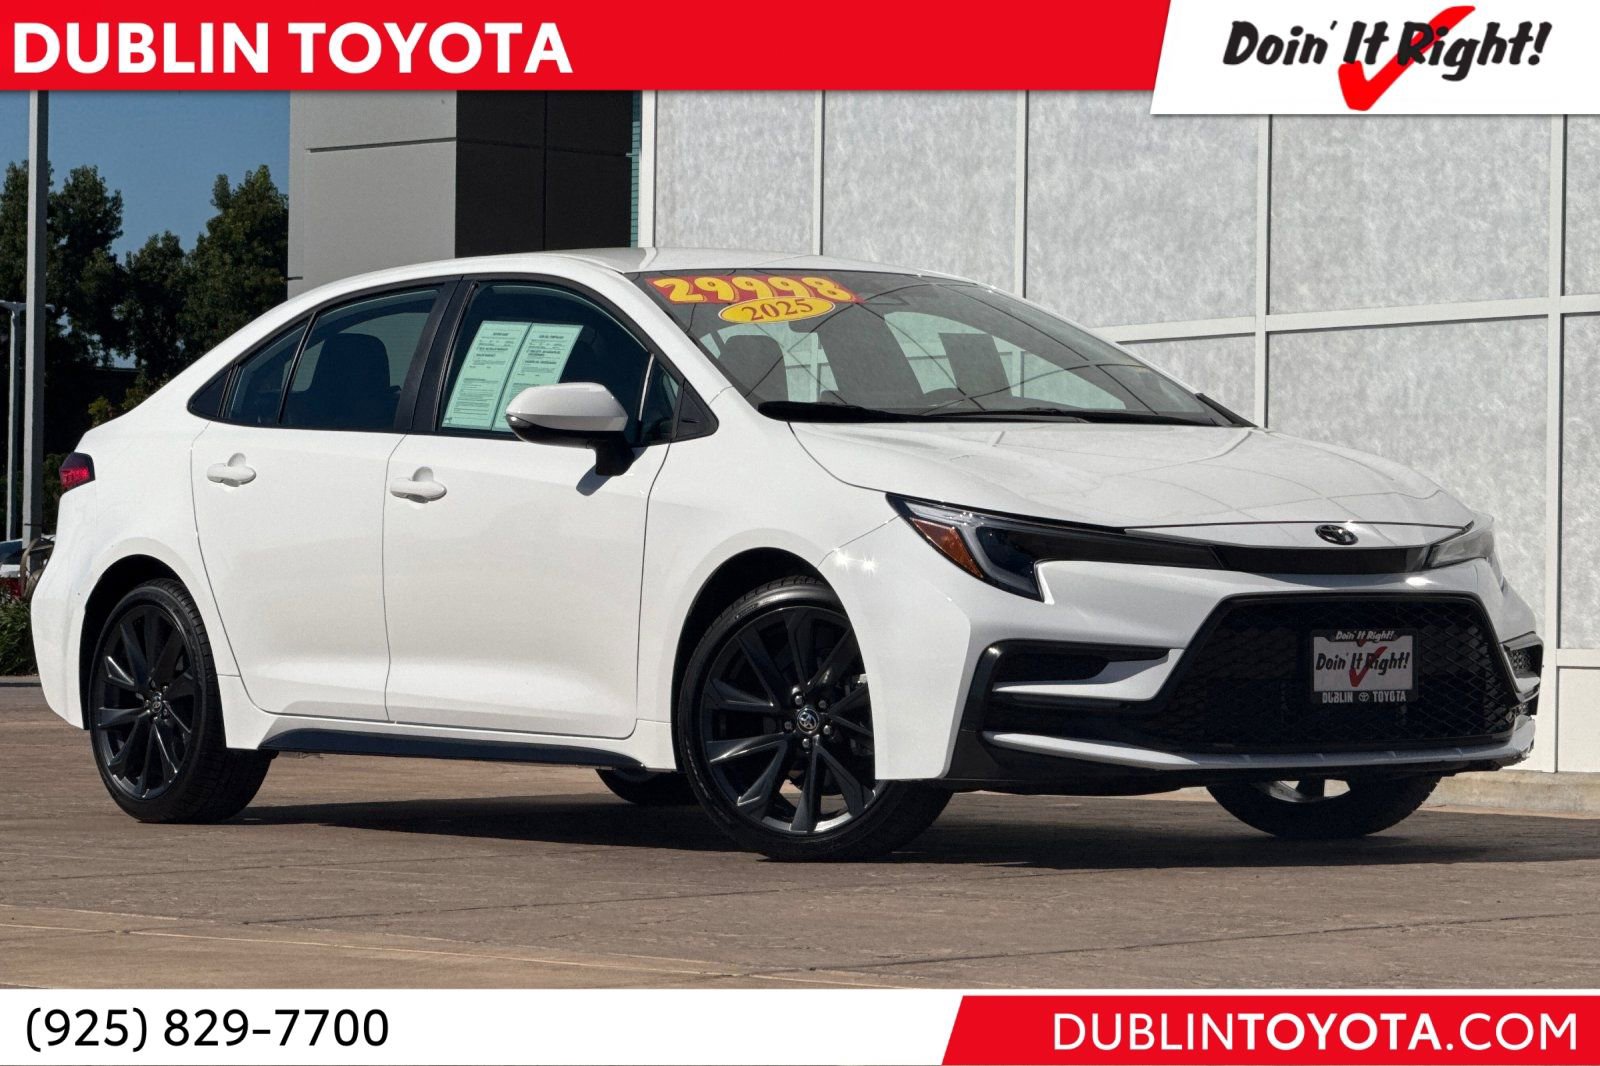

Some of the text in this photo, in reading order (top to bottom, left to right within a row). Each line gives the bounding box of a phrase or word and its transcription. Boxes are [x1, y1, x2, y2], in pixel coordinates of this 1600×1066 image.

[653, 276, 853, 303] 29998
[742, 298, 814, 322] 2025
[1357, 630, 1366, 640] It
[1366, 630, 1395, 643] Right!
[1316, 652, 1410, 676] Doin' It Right!
[1322, 691, 1406, 704] DUBLIN TOYOTA
